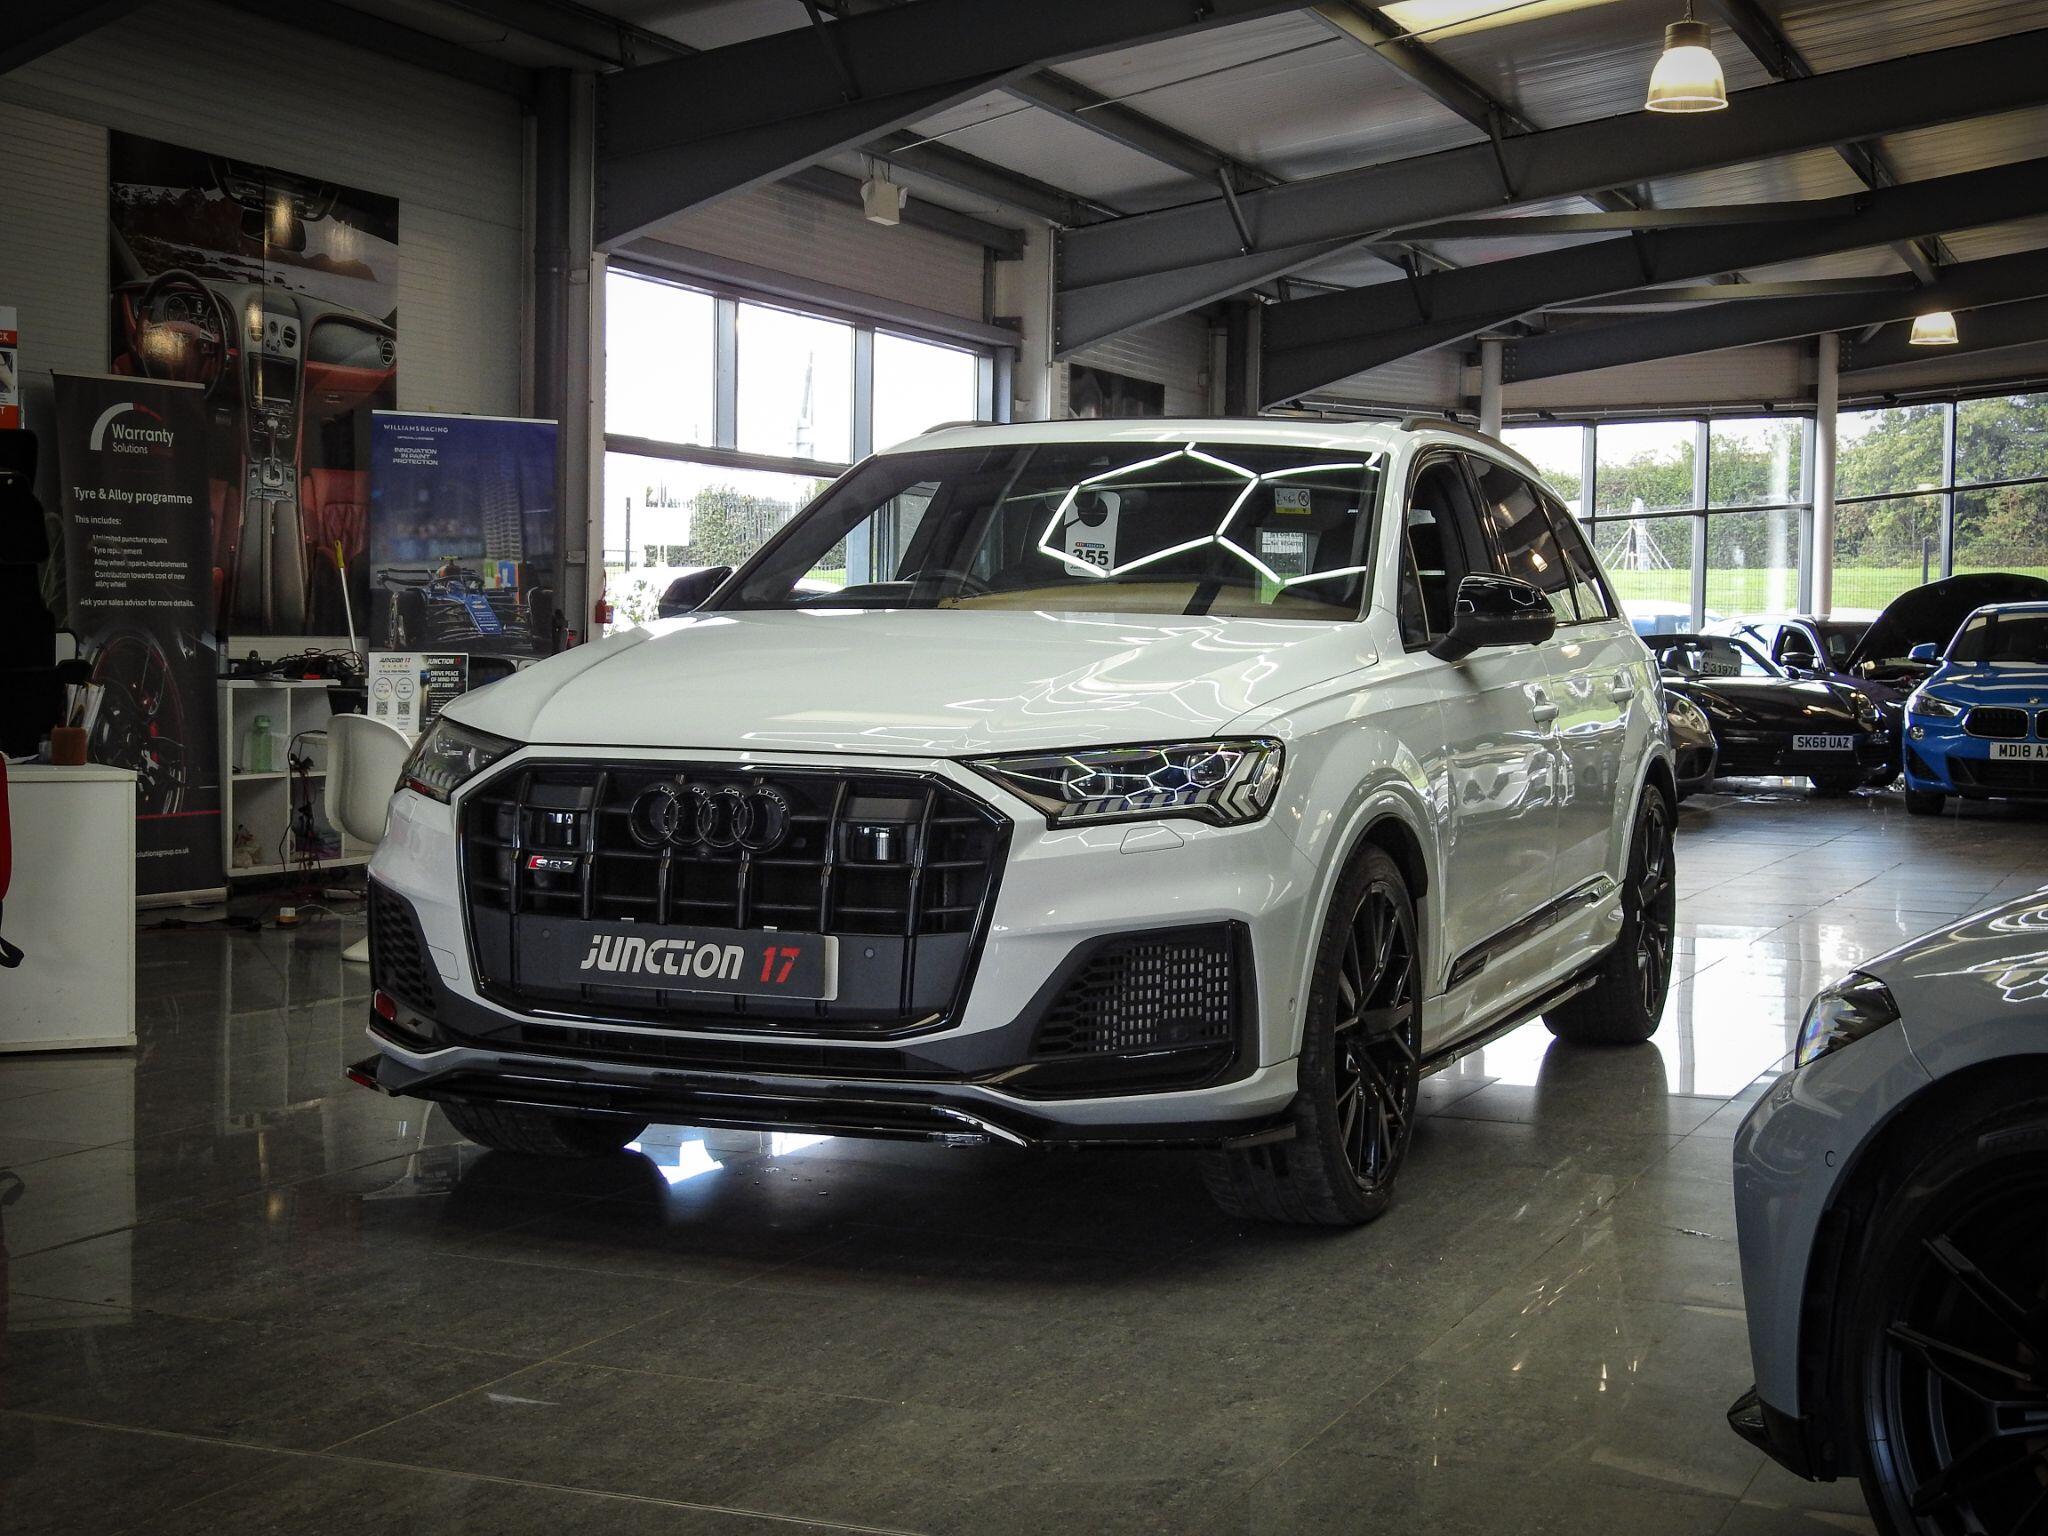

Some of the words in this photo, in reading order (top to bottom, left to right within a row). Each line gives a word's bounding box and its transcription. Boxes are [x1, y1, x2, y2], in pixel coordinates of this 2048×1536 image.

[383, 424, 419, 432] WILLIAMS
[111, 423, 174, 448] Warranty
[112, 442, 149, 454] Solutions
[73, 487, 97, 501] Tyre
[98, 488, 107, 500] &
[108, 488, 134, 503] Alloy
[135, 492, 193, 504] programme
[75, 514, 90, 524] This
[90, 516, 122, 525] includes:
[1797, 736, 1827, 748] SK68
[1829, 736, 1850, 749] UAZ
[1999, 744, 2031, 758] MD18
[536, 859, 574, 870] SQ7
[760, 946, 800, 983] 17
